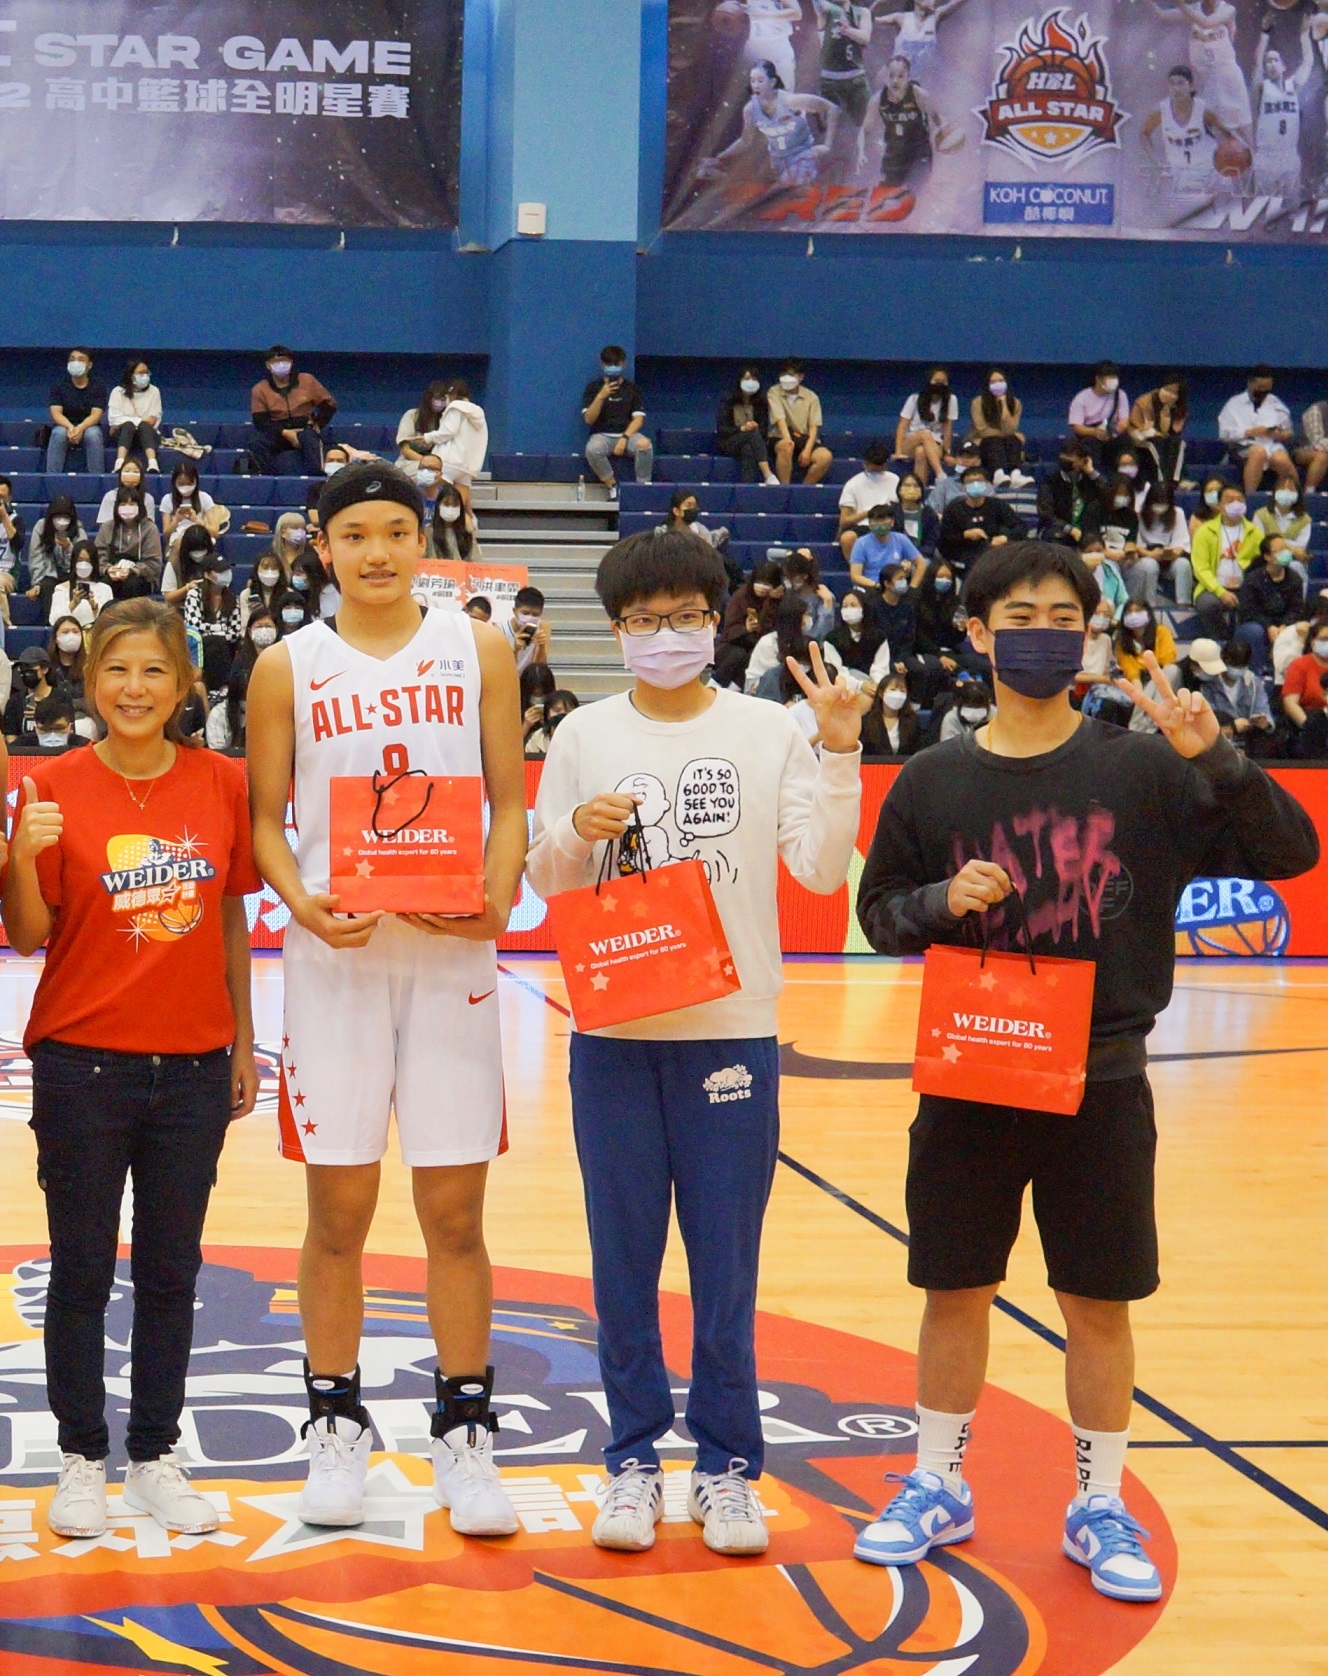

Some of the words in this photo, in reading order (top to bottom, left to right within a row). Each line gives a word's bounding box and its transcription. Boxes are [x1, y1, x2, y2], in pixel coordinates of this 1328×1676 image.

[34, 32, 201, 69] STAR
[223, 35, 412, 75] GAME
[1027, 72, 1076, 90] HBL
[45, 76, 410, 119] 高中籃球全明星賽
[998, 103, 1042, 120] ALL
[1046, 101, 1104, 121] STAR
[990, 187, 1025, 203] KOH
[311, 694, 373, 743] ALL
[380, 685, 464, 727] STAR
[693, 767, 713, 780] IT'S
[717, 769, 732, 780] SO
[683, 783, 717, 796] GOOD
[719, 782, 734, 795] TO
[684, 797, 706, 811] SEE
[710, 797, 735, 808] YOU
[683, 811, 730, 825] AGAIN!
[708, 1089, 752, 1103] Roots
